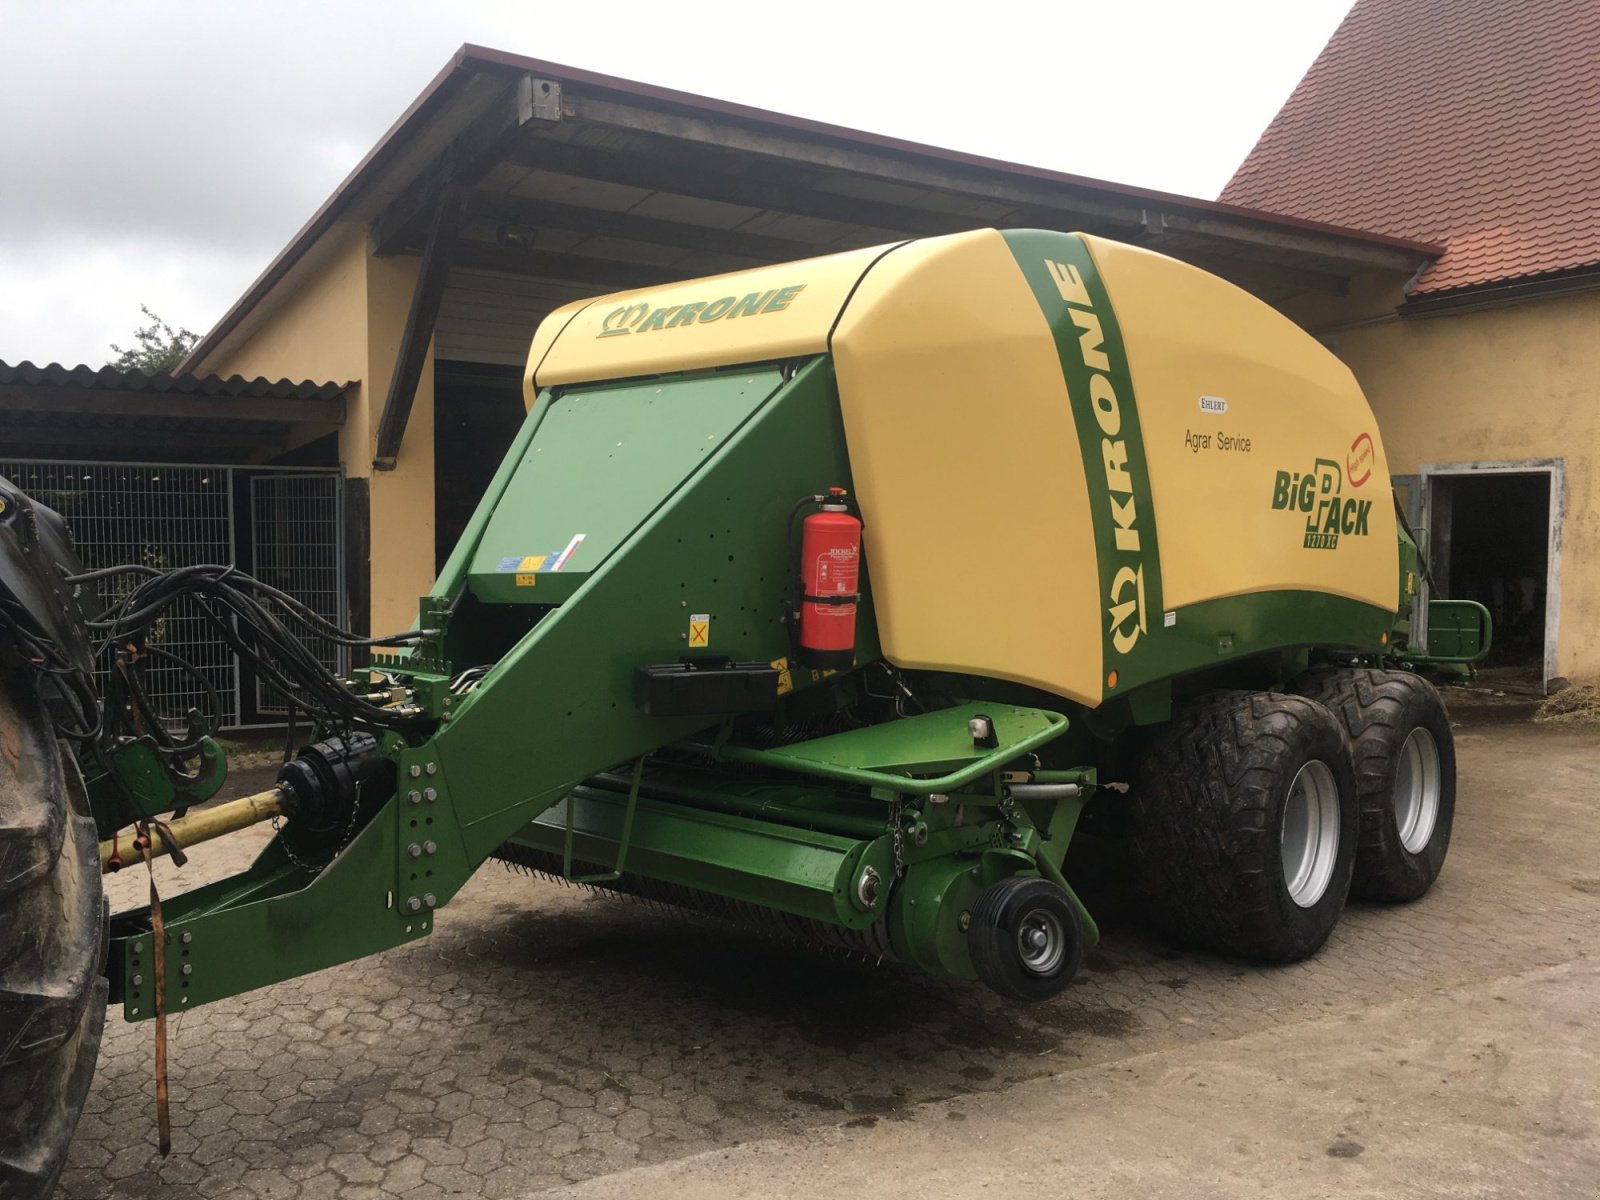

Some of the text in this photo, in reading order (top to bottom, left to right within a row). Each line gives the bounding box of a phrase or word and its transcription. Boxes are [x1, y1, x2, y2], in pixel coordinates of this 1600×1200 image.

[636, 285, 807, 333] KRONE
[1045, 259, 1141, 551] KRONE
[1185, 428, 1251, 453] Agrar Service
